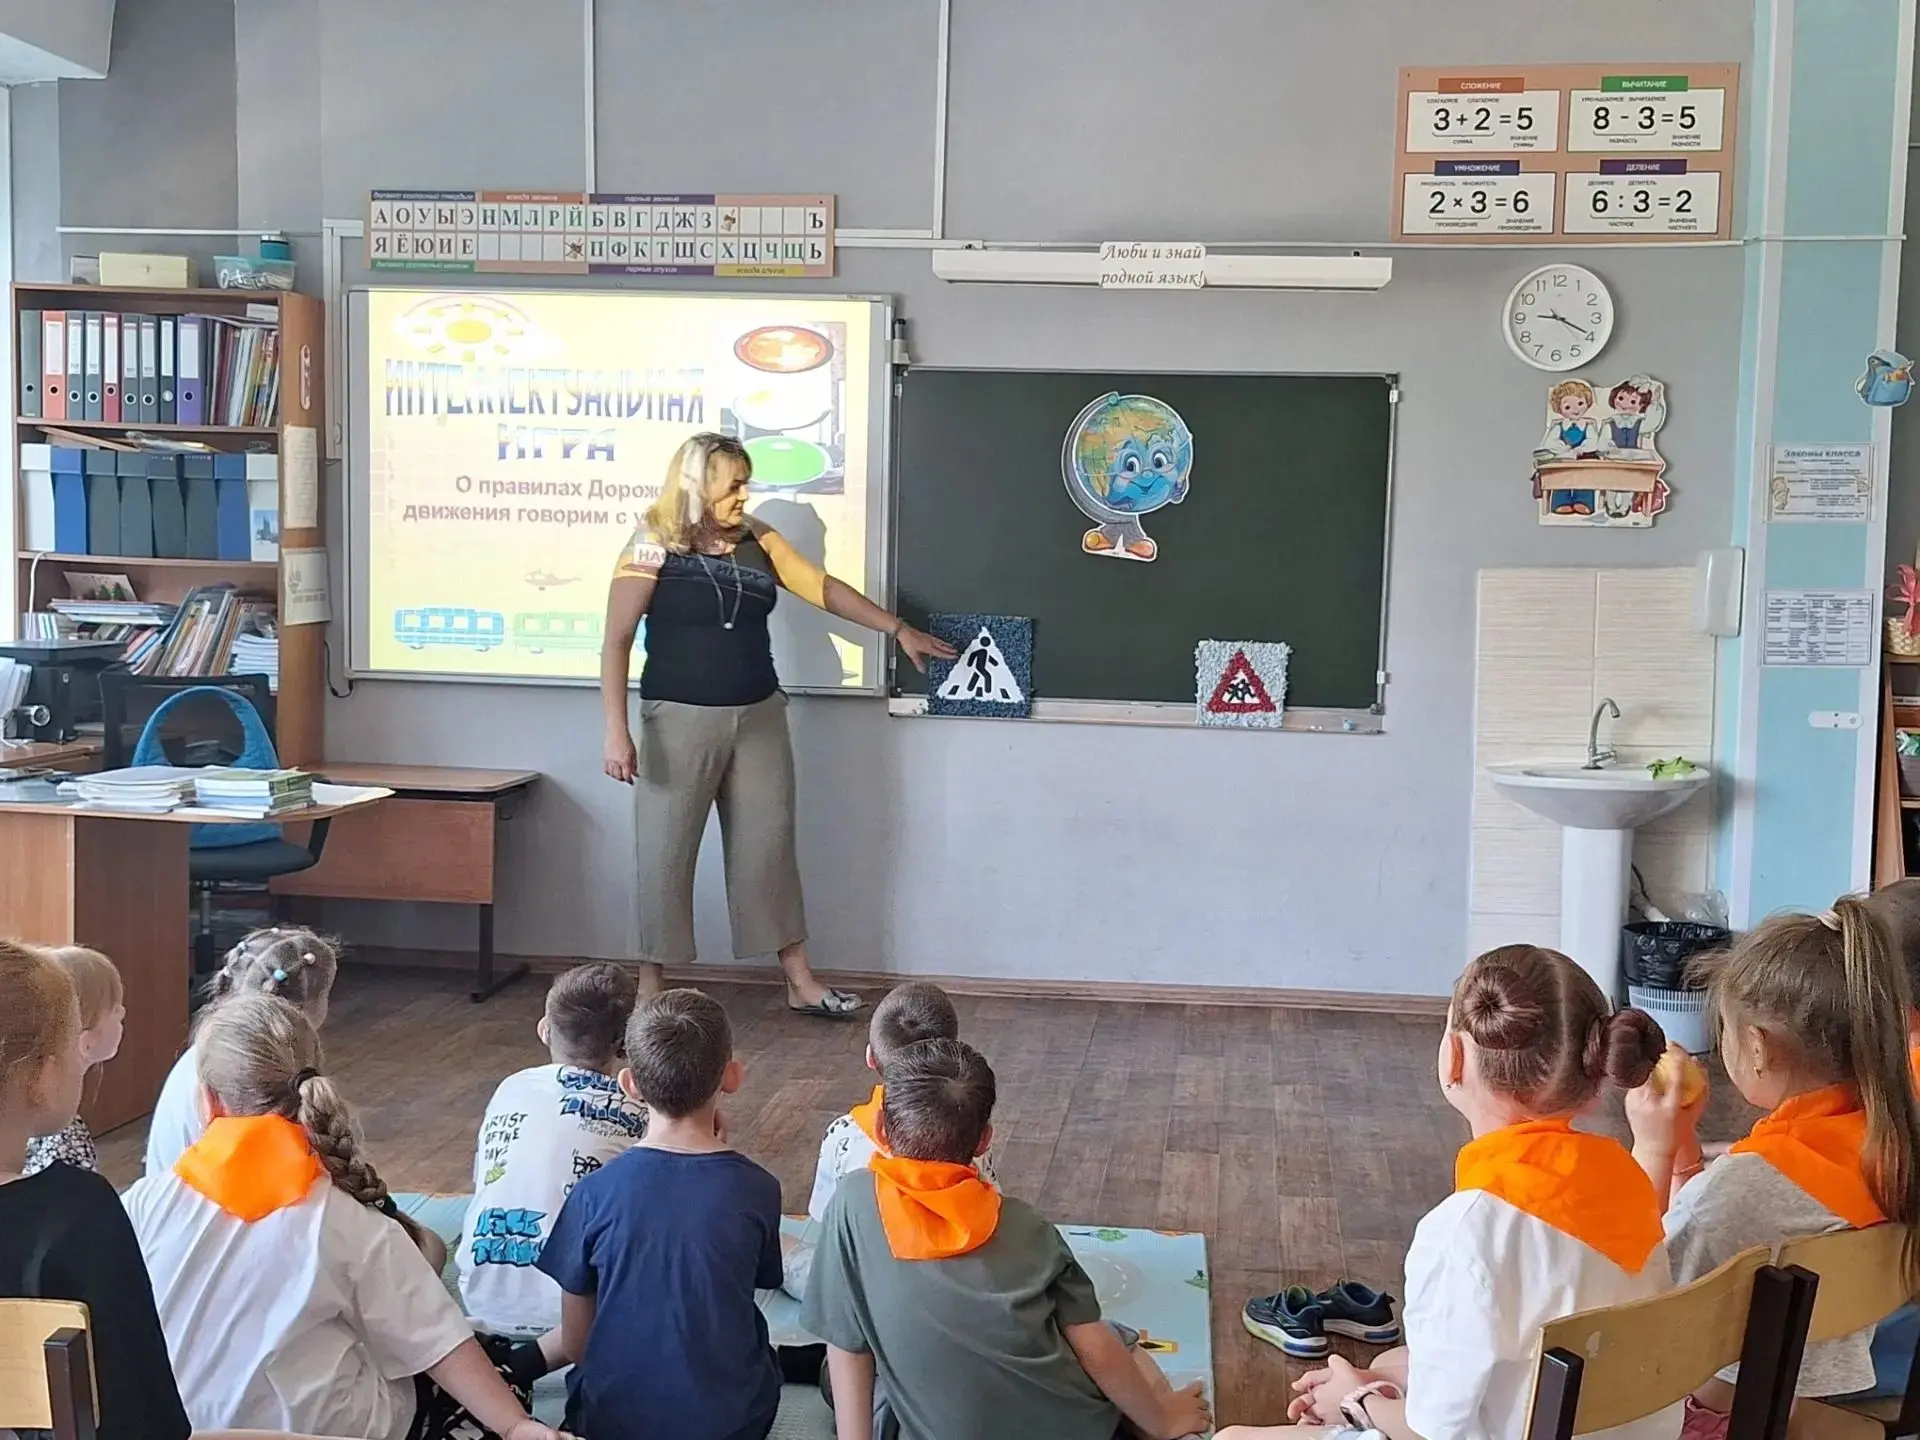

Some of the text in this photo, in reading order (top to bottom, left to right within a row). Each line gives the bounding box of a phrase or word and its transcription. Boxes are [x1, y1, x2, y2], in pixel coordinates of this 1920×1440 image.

[1460, 82, 1502, 90] СЛОЖЕНИЕ
[1621, 80, 1668, 88] ВЫЧИТАНИЕ
[1433, 107, 1450, 131] 3
[1474, 107, 1491, 130] 2
[1516, 107, 1533, 130] 5
[1593, 106, 1610, 130] 8
[1638, 106, 1655, 130] 3
[1679, 105, 1696, 129] 5
[1454, 164, 1501, 172] УМНОЖЕНИЕ
[1625, 163, 1661, 171] ДЕЛЕНИЕ
[1429, 190, 1446, 213] 2
[1470, 190, 1487, 214] 3
[1513, 190, 1530, 214] 6
[1592, 190, 1609, 213] 6
[1633, 190, 1650, 213] 3
[1675, 190, 1692, 213] 2
[374, 206, 823, 231] А О У Ы Э Н М Л Р Й Б В Г Д Ж З Ъ
[374, 233, 822, 262] Я Ё Ю И Е П Ф К Т Ш С Х Ц Ч Щ Ь
[1101, 243, 1202, 261] Люби и знай
[1101, 268, 1204, 288] родной язык!
[1553, 274, 1568, 288] 12
[1536, 279, 1546, 292] 11
[1576, 279, 1581, 292] 1
[1521, 293, 1536, 306] 10
[1586, 293, 1598, 306] 2
[1514, 312, 1526, 325] 9
[1590, 312, 1602, 325] 3
[1520, 331, 1532, 344] 8
[1584, 331, 1595, 343] 4
[1533, 344, 1544, 357] 7
[1550, 349, 1562, 362] 6
[1569, 344, 1582, 357] 5
[1784, 449, 1823, 458] Законы
[455, 475, 472, 493] О
[478, 479, 583, 498] правилах
[402, 502, 511, 522] движения
[517, 506, 609, 527] говорим
[615, 511, 627, 525] с
